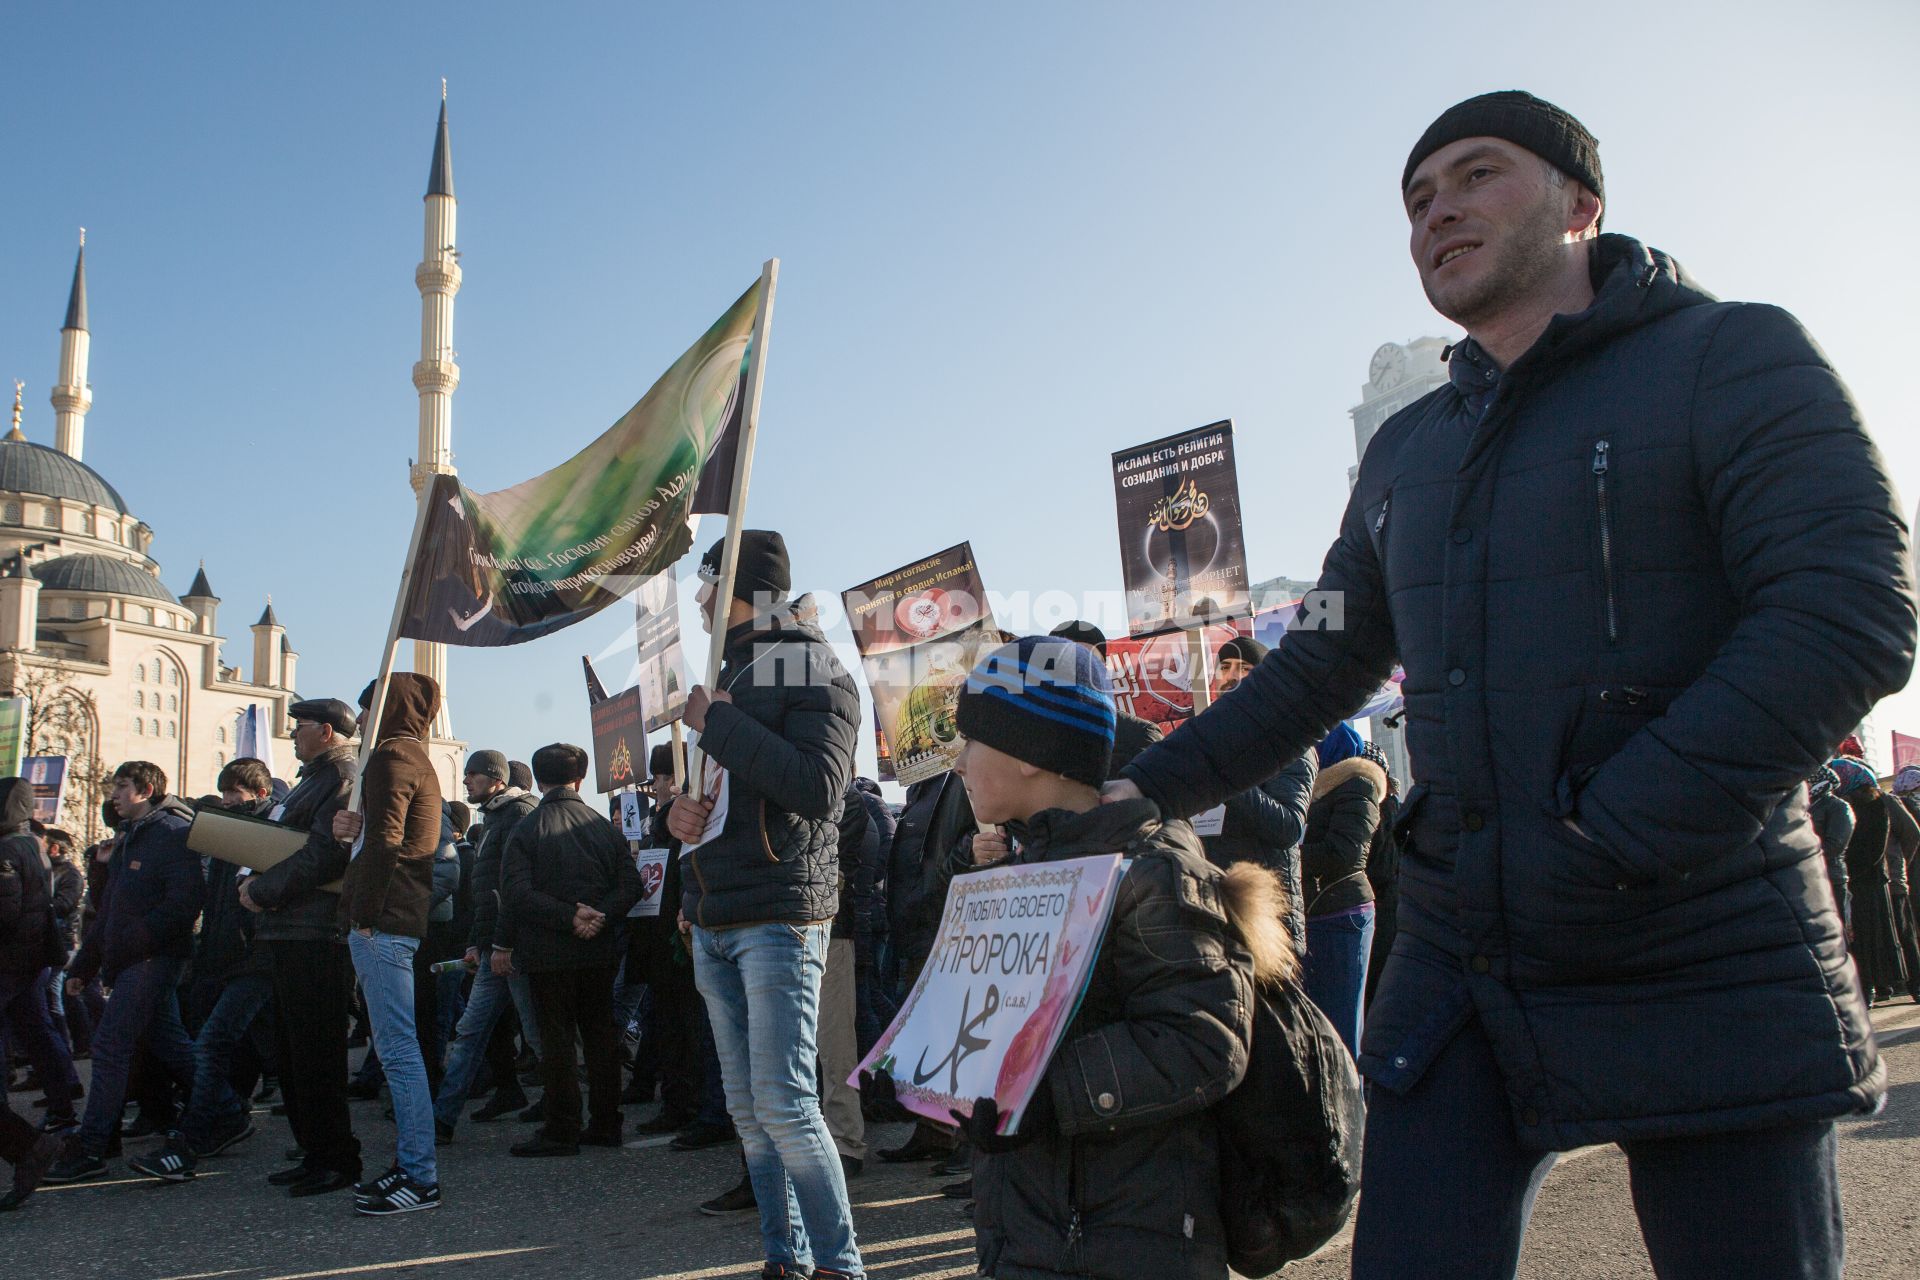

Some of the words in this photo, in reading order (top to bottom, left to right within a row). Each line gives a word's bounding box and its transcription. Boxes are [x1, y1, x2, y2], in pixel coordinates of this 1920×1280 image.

[1117, 452, 1151, 473] ИСЛАМ
[1153, 447, 1176, 464] ЕСТЬ
[1177, 433, 1223, 456] РЕЛИГИЯ
[1122, 464, 1179, 488] СОЗИДАНИЯ
[1181, 460, 1189, 472] И
[1191, 451, 1224, 471] ДОБРА
[611, 499, 661, 536] сынов
[854, 593, 896, 615] хранятся
[896, 589, 903, 598] в
[903, 576, 935, 596] сердце
[936, 560, 974, 583] Ислама!
[874, 575, 895, 590] Мир
[895, 573, 902, 581] и
[902, 558, 942, 579] согласие
[951, 895, 964, 924] Я
[964, 898, 1007, 922] ЛЮБЛЮ
[1009, 893, 1065, 919] СВОЕГО
[940, 932, 1050, 975] ПРОРОКА
